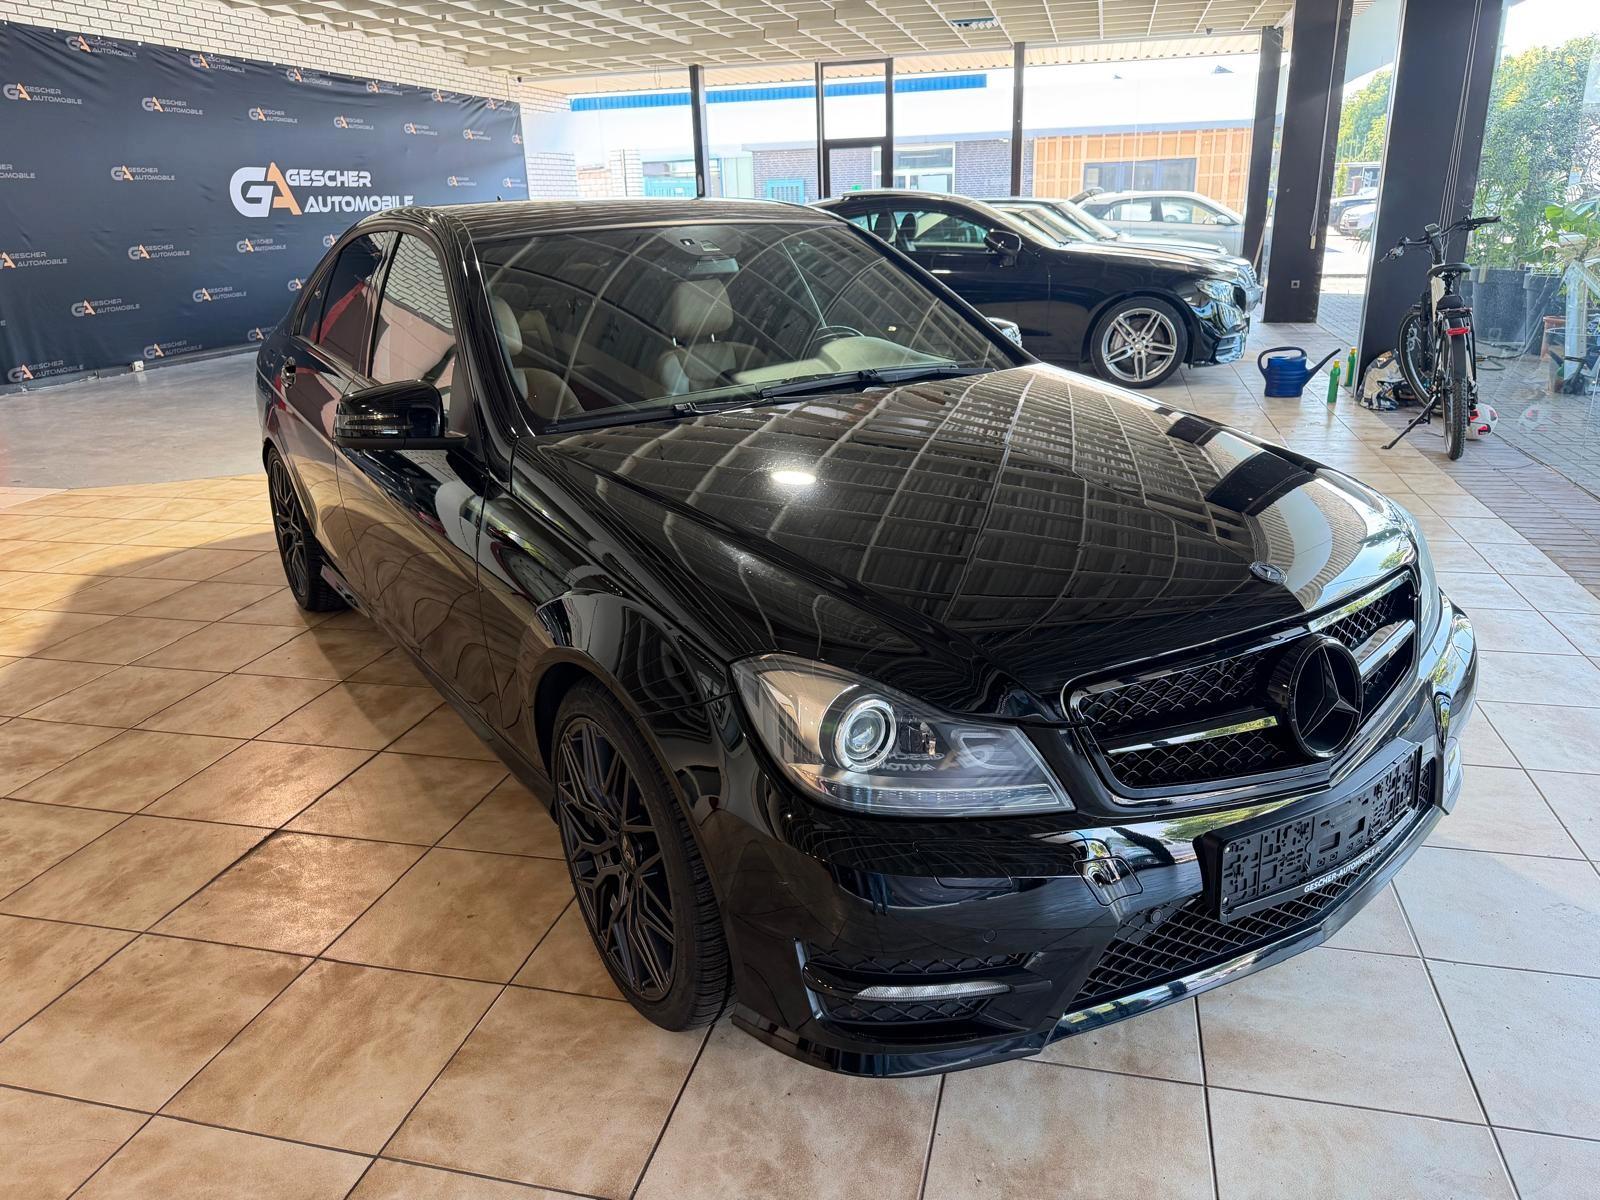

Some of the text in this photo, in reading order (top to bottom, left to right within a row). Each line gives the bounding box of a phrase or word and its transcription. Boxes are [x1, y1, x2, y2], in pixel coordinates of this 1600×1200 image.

[3, 82, 31, 101] GA
[24, 85, 62, 95] GESCHER
[32, 95, 83, 105] AUTOMOBILE
[141, 96, 164, 112] GA
[157, 98, 187, 107] GESCHER
[164, 106, 203, 116] AUTOMOBILE
[248, 106, 266, 121] GA
[0, 163, 13, 171] ER
[110, 165, 134, 181] GA
[285, 168, 372, 188] GESCHER
[229, 161, 303, 218] GA
[304, 195, 414, 213] AUTOMOBILE
[128, 244, 150, 260] GA
[236, 238, 254, 253] GA
[0, 251, 16, 269] A
[9, 251, 47, 259] GESCHER
[150, 250, 191, 258] AUTOMOBILE
[17, 258, 68, 267] AUTOMOBILE
[90, 298, 122, 307] GESCHER
[192, 287, 212, 303] GA
[211, 291, 247, 300] AUTOMOBILE
[71, 299, 96, 317] GA
[96, 303, 140, 314] AUTOMOBILE
[144, 343, 165, 360] GA
[28, 360, 64, 370] GESCHER
[34, 364, 84, 377] AUTOMOBILE
[7, 364, 34, 383] GA
